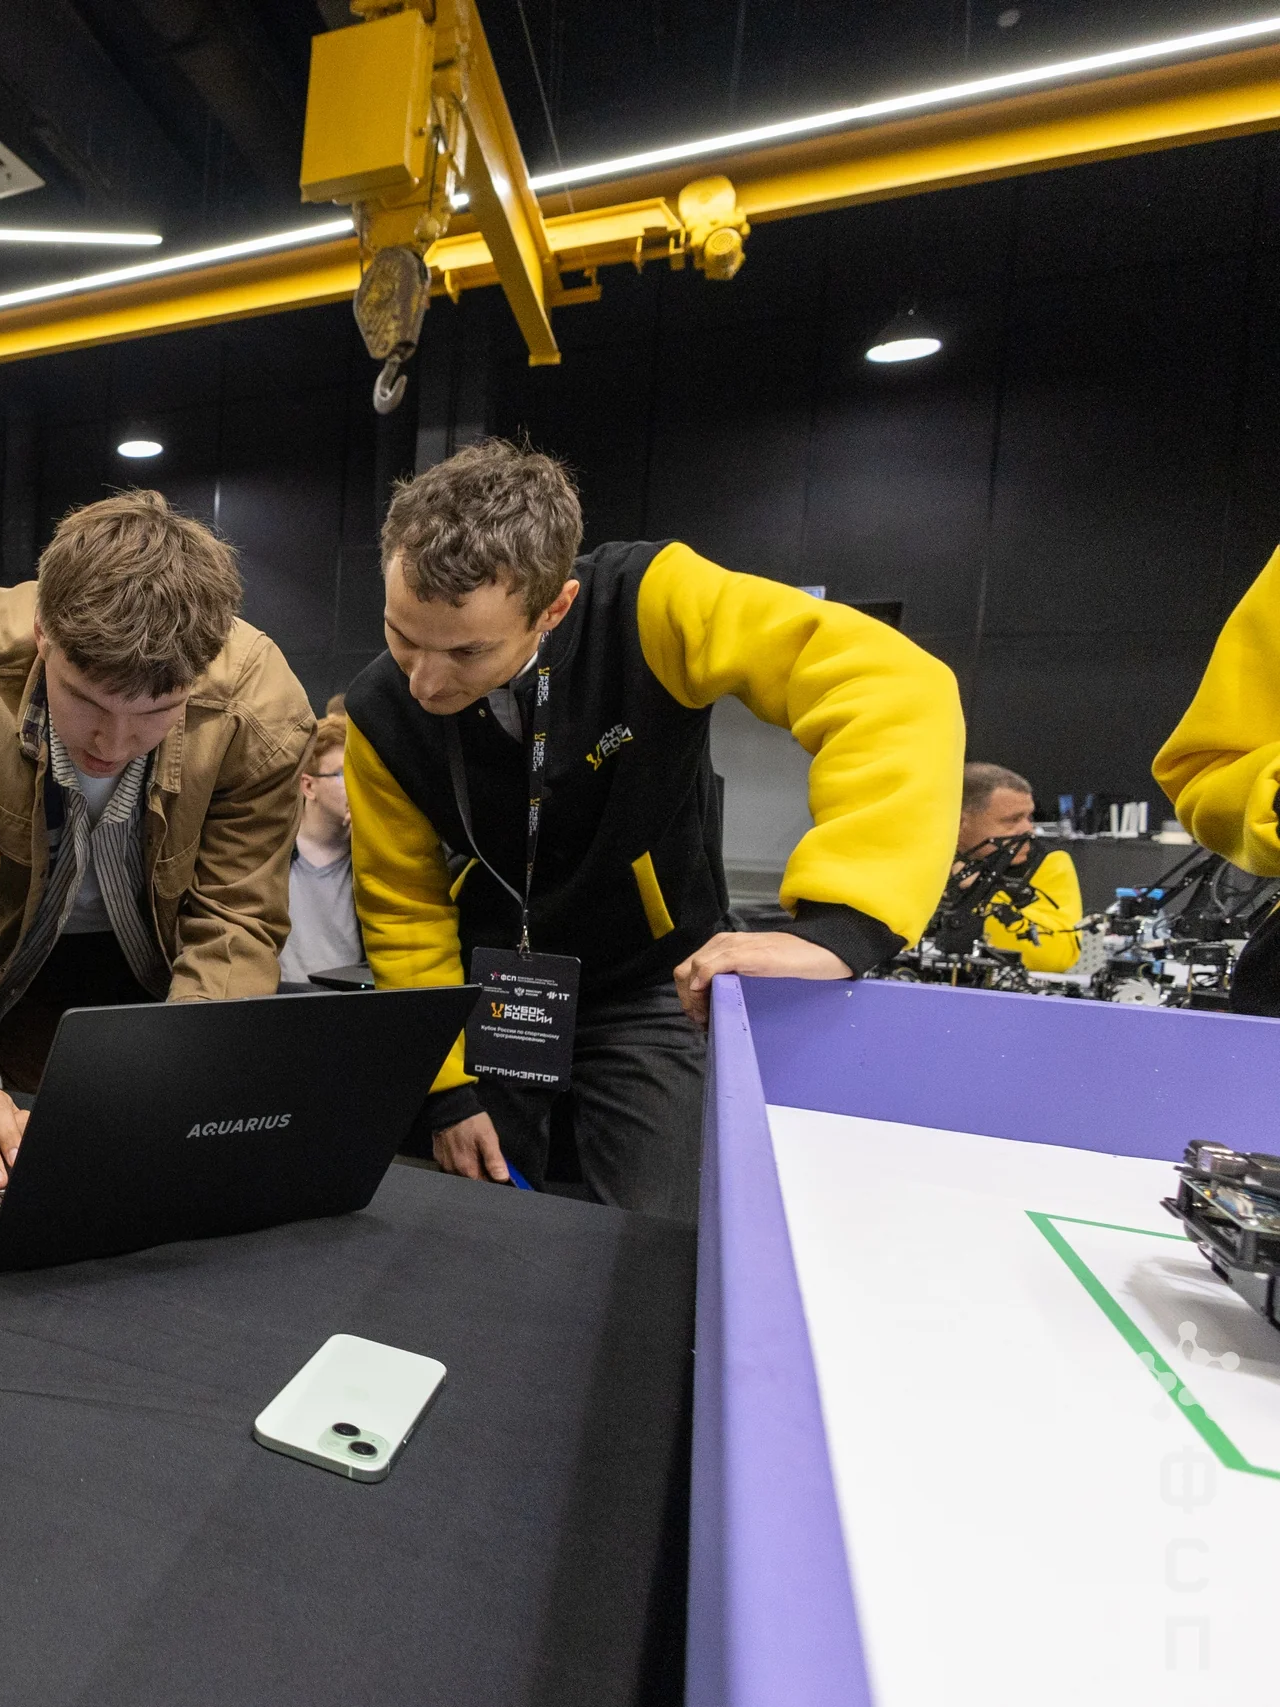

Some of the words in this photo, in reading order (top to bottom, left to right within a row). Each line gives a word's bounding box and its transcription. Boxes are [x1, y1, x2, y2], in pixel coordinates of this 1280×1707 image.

[504, 1004, 545, 1015] КУБОК
[504, 1011, 553, 1024] РОССИИ
[474, 1064, 559, 1083] ОРГАНИЗАТОР
[186, 1113, 292, 1138] AQUARIUS
